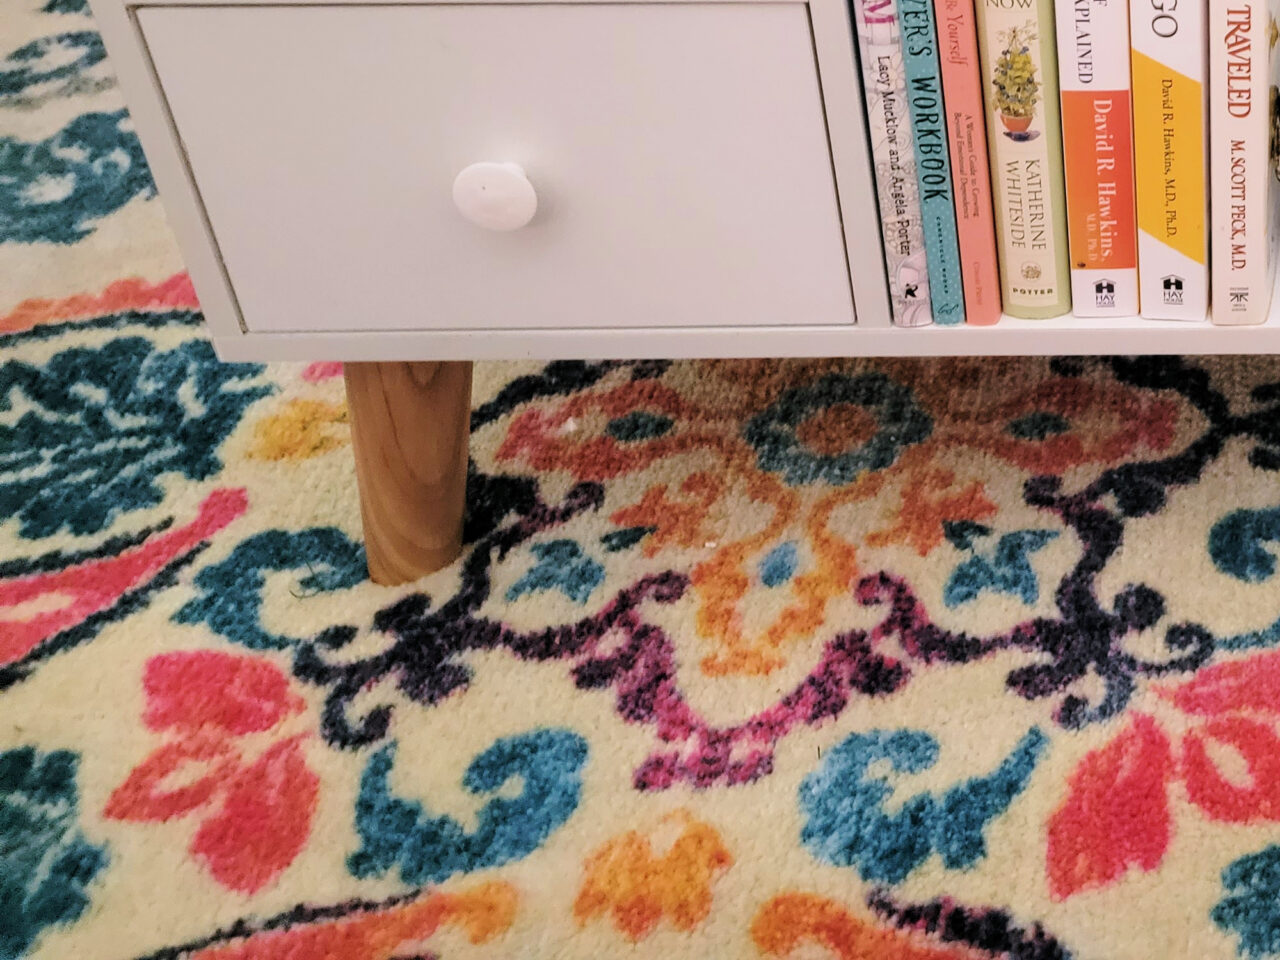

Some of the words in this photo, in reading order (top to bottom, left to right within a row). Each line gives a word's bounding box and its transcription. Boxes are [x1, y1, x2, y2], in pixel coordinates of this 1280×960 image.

[948, 14, 968, 66] Yourself
[877, 56, 890, 86] Lacy
[1224, 5, 1251, 118] TRAVELED
[1162, 79, 1173, 111] David
[882, 91, 898, 145] Mucklow
[1093, 99, 1114, 151] David
[1162, 113, 1174, 125] R.
[911, 76, 949, 203] WORKBOOK
[1163, 128, 1174, 175] Hawkins,
[1231, 140, 1245, 154] M.
[889, 149, 900, 171] and
[1096, 157, 1115, 175] R.
[1231, 157, 1246, 201] SCOTT
[891, 176, 908, 216] Angela
[1006, 160, 1026, 248] WHITESIDE
[1025, 159, 1047, 250] KATHERINE
[897, 219, 910, 256] Porter
[1166, 210, 1177, 238] Ph.D.
[1231, 205, 1246, 240] PECK,
[1231, 244, 1246, 271] M.D.
